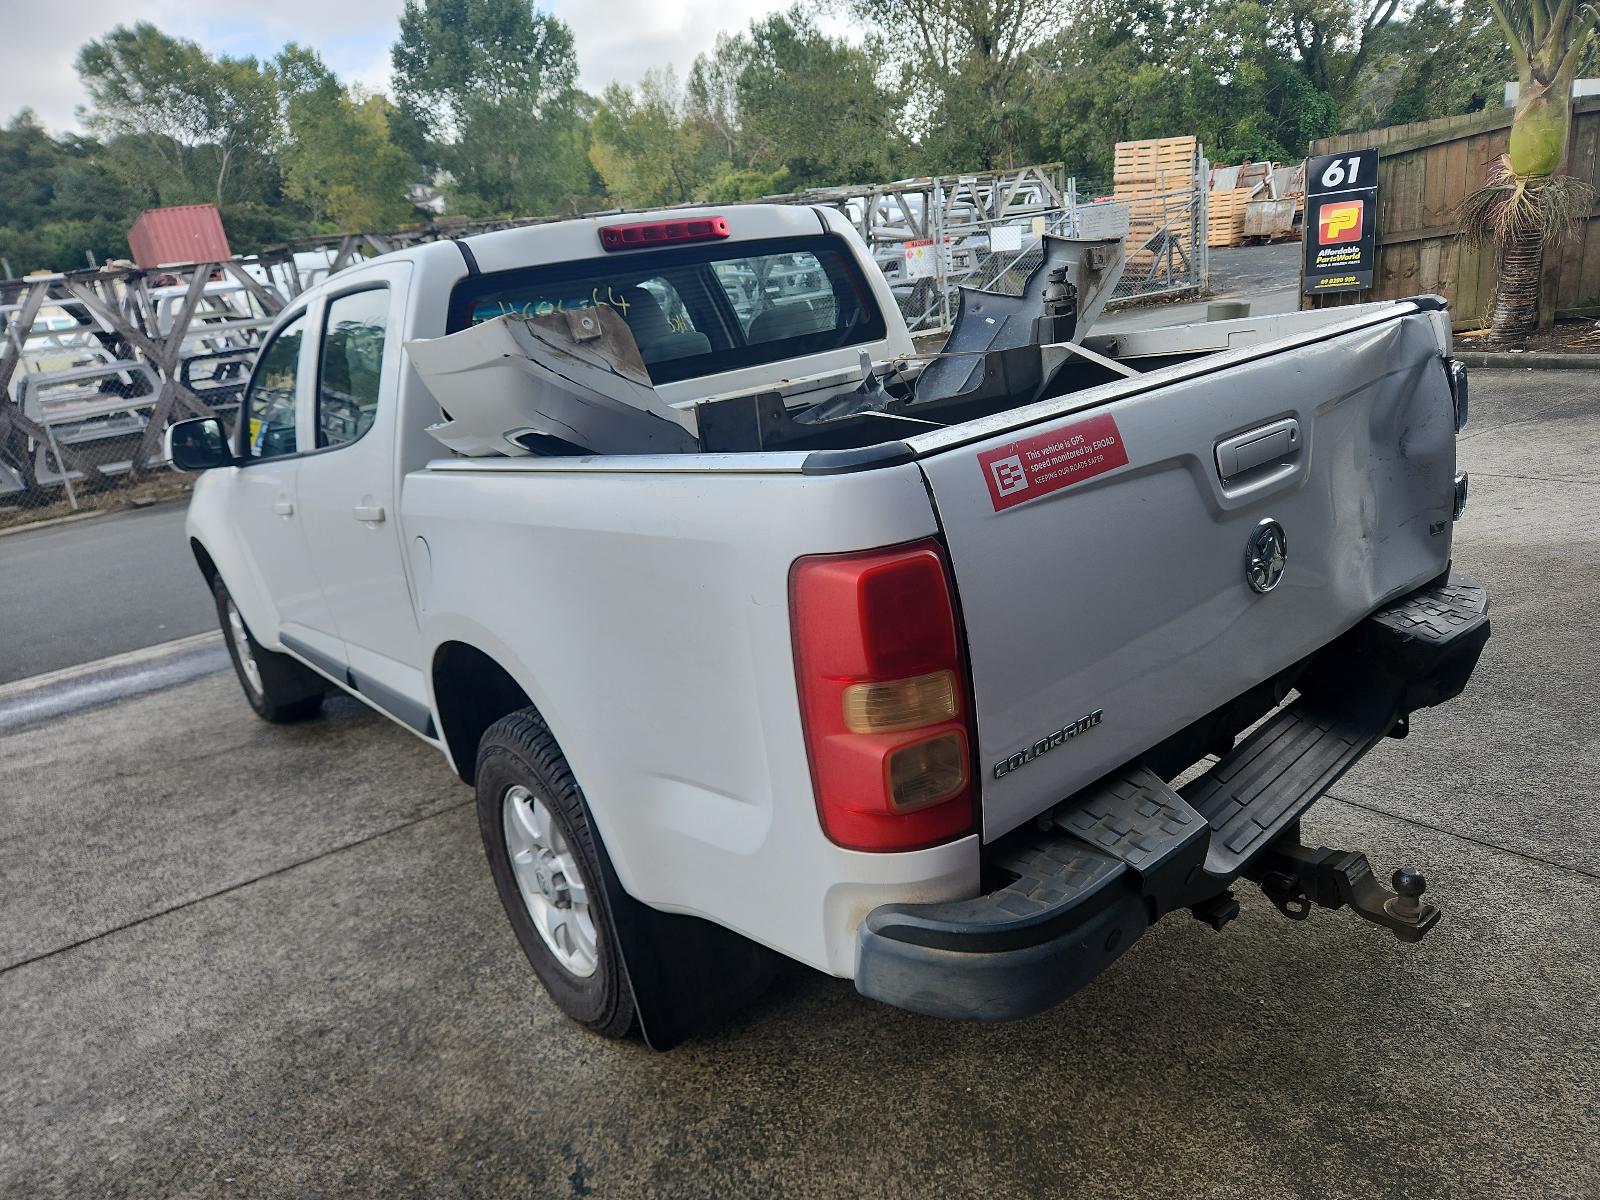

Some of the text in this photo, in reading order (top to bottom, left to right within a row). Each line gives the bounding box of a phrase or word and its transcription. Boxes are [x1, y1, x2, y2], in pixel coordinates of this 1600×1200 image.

[1321, 157, 1361, 188] 61
[1316, 252, 1361, 264] PartsWorld
[1318, 246, 1360, 257] Affordable
[1025, 434, 1085, 461] This vehicle is GPS
[1030, 436, 1115, 473] speed monitored by EROAD
[1034, 454, 1105, 485] KEEPING OUR ROADS SAFER
[994, 708, 1104, 779] COLORADO
